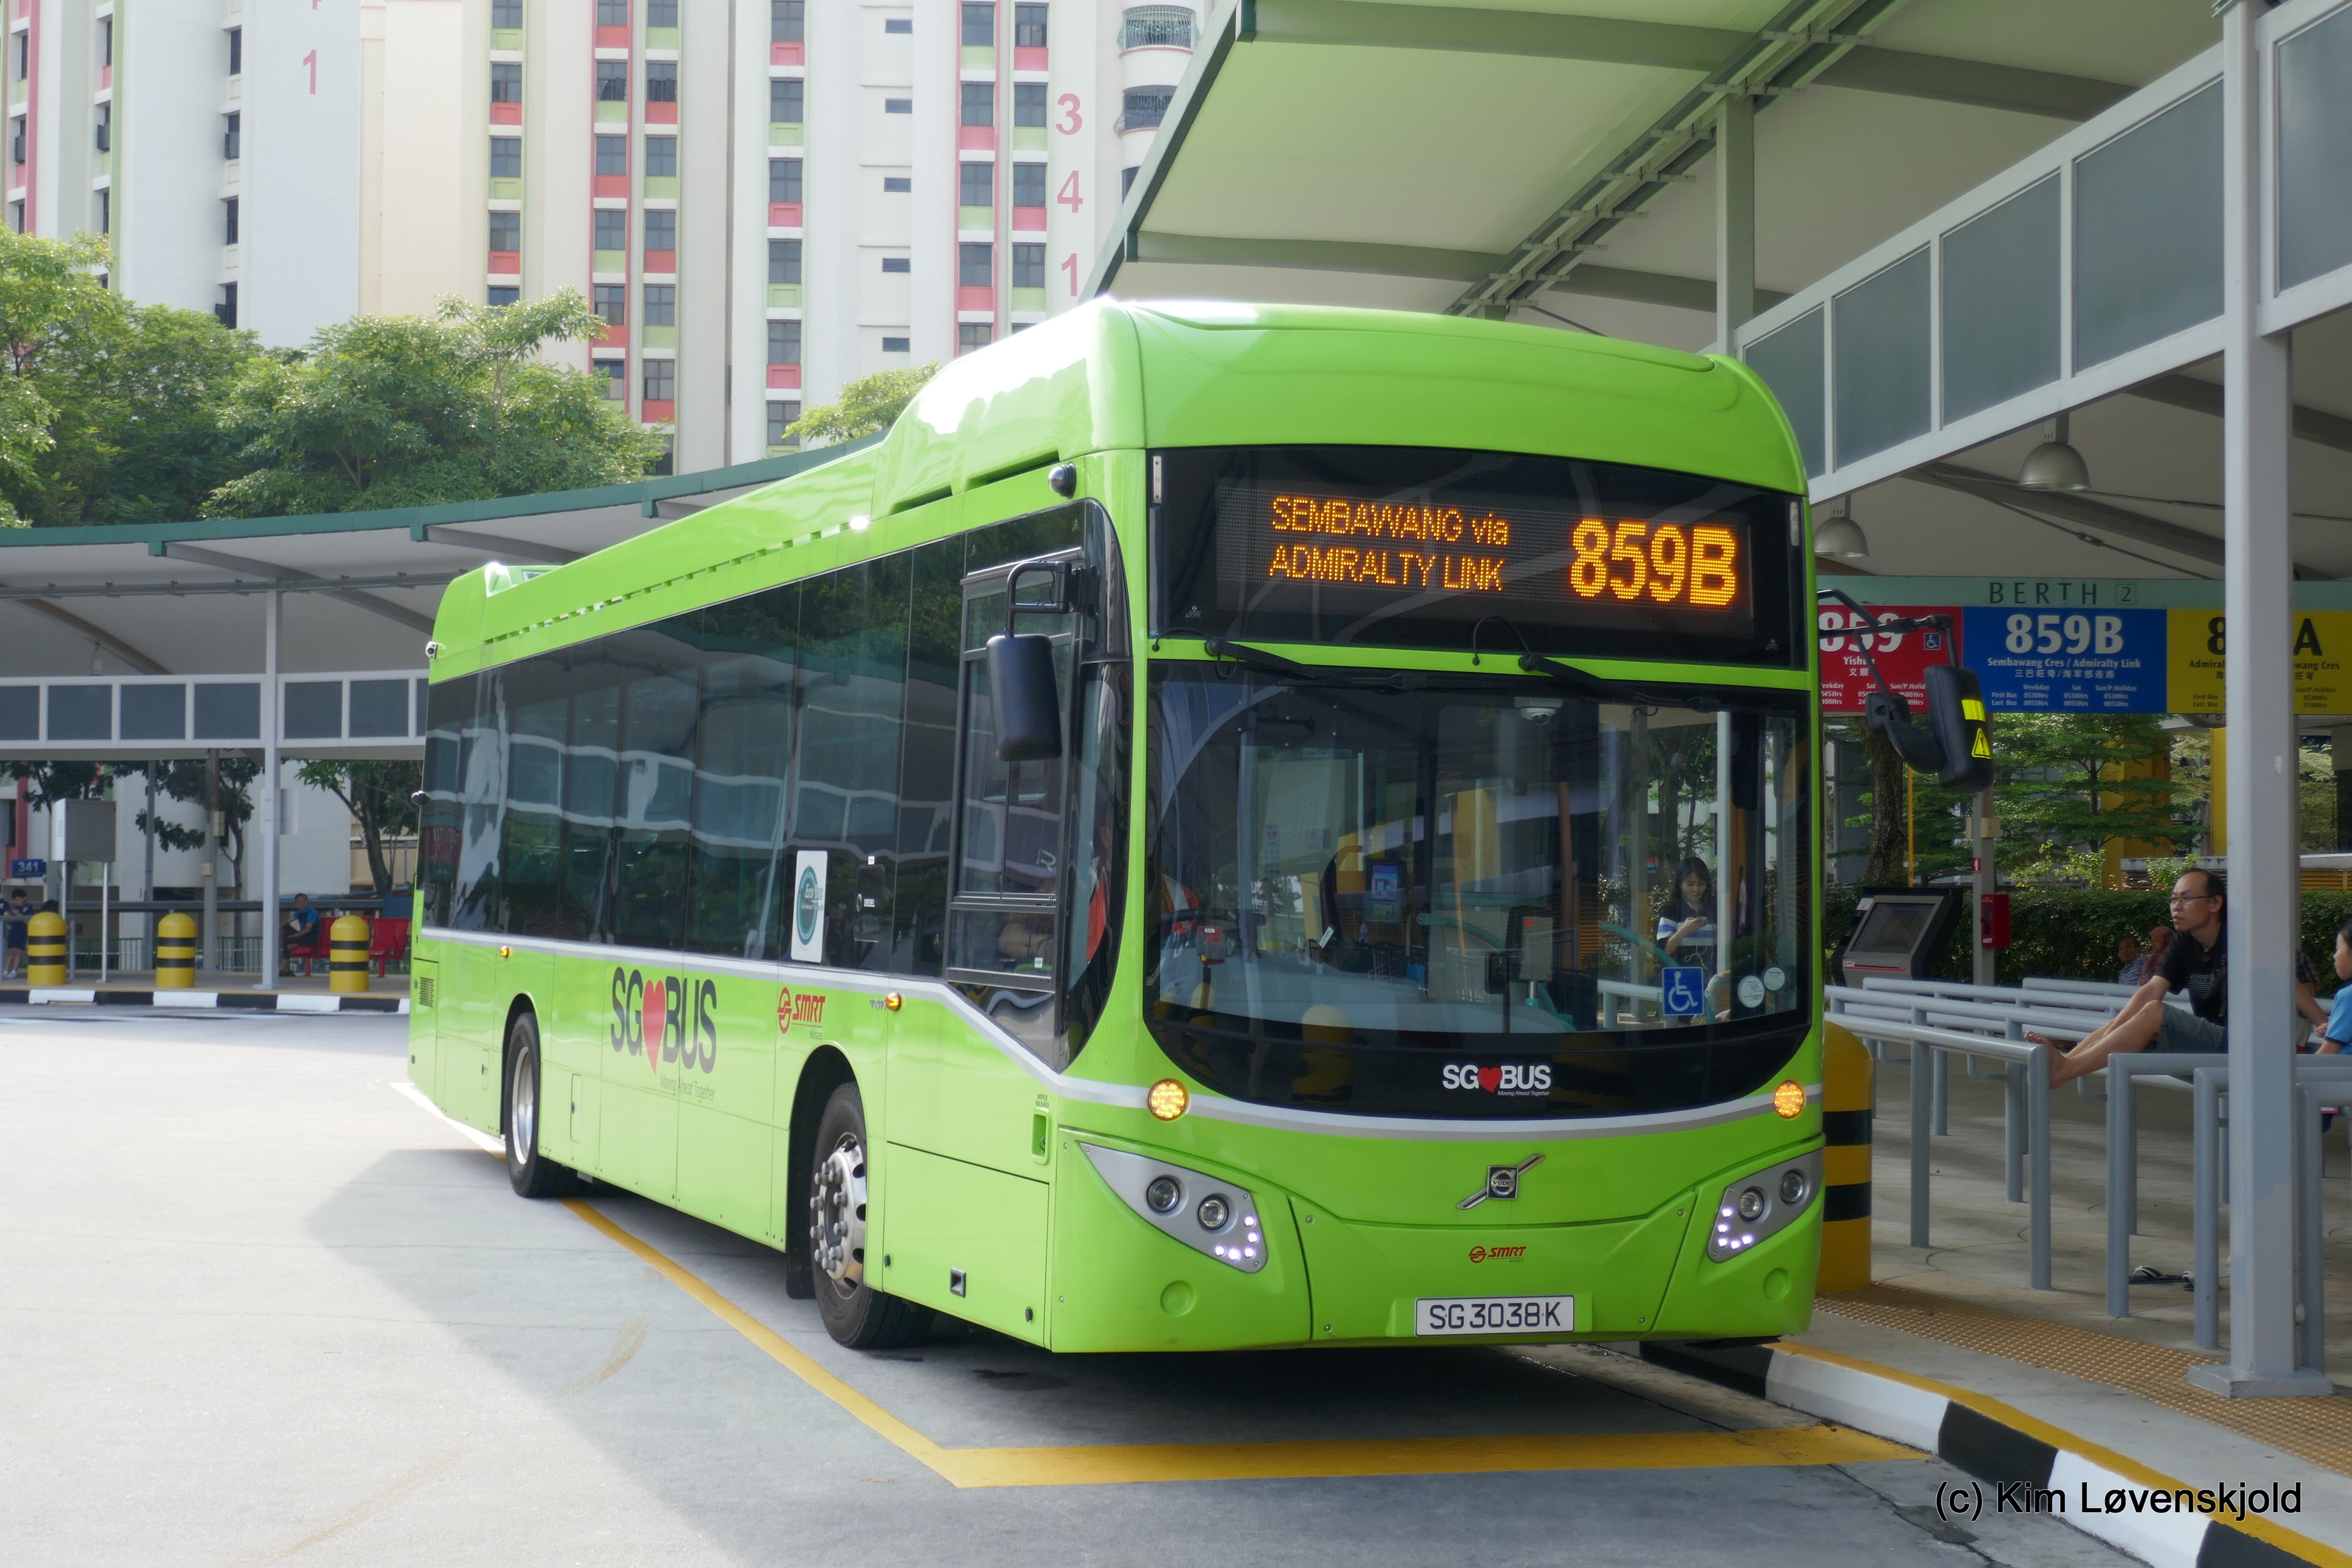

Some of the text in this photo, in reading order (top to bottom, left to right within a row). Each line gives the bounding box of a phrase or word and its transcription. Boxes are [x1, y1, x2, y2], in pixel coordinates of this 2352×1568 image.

[1271, 497, 1509, 547] SEMBAWANG via
[1268, 543, 1505, 592] ADMIRALTY LINK
[1570, 519, 1737, 606] 859B
[1989, 582, 2132, 605] BERTH 2
[1819, 612, 1903, 653] 859
[2005, 614, 2124, 655] 859B
[2207, 617, 2323, 656] 8A
[1987, 657, 2043, 669] Sembawang
[2045, 658, 2064, 667] Cres
[2073, 658, 2119, 669] Admiralty
[2121, 659, 2141, 668] Link
[2188, 660, 2226, 668] Admiral
[18, 861, 39, 872] 341
[864, 899, 875, 907] DIESEL
[610, 967, 717, 1074] SG BUS
[792, 993, 826, 1023] SMRT
[660, 1072, 715, 1103] Moving Ahead Together
[1442, 1065, 1551, 1090] SG BUS
[1036, 1101, 1050, 1109] WASHER
[1037, 1093, 1048, 1102] WIPER
[1488, 1246, 1527, 1258] SMRT
[1430, 1302, 1561, 1329] SG3038K
